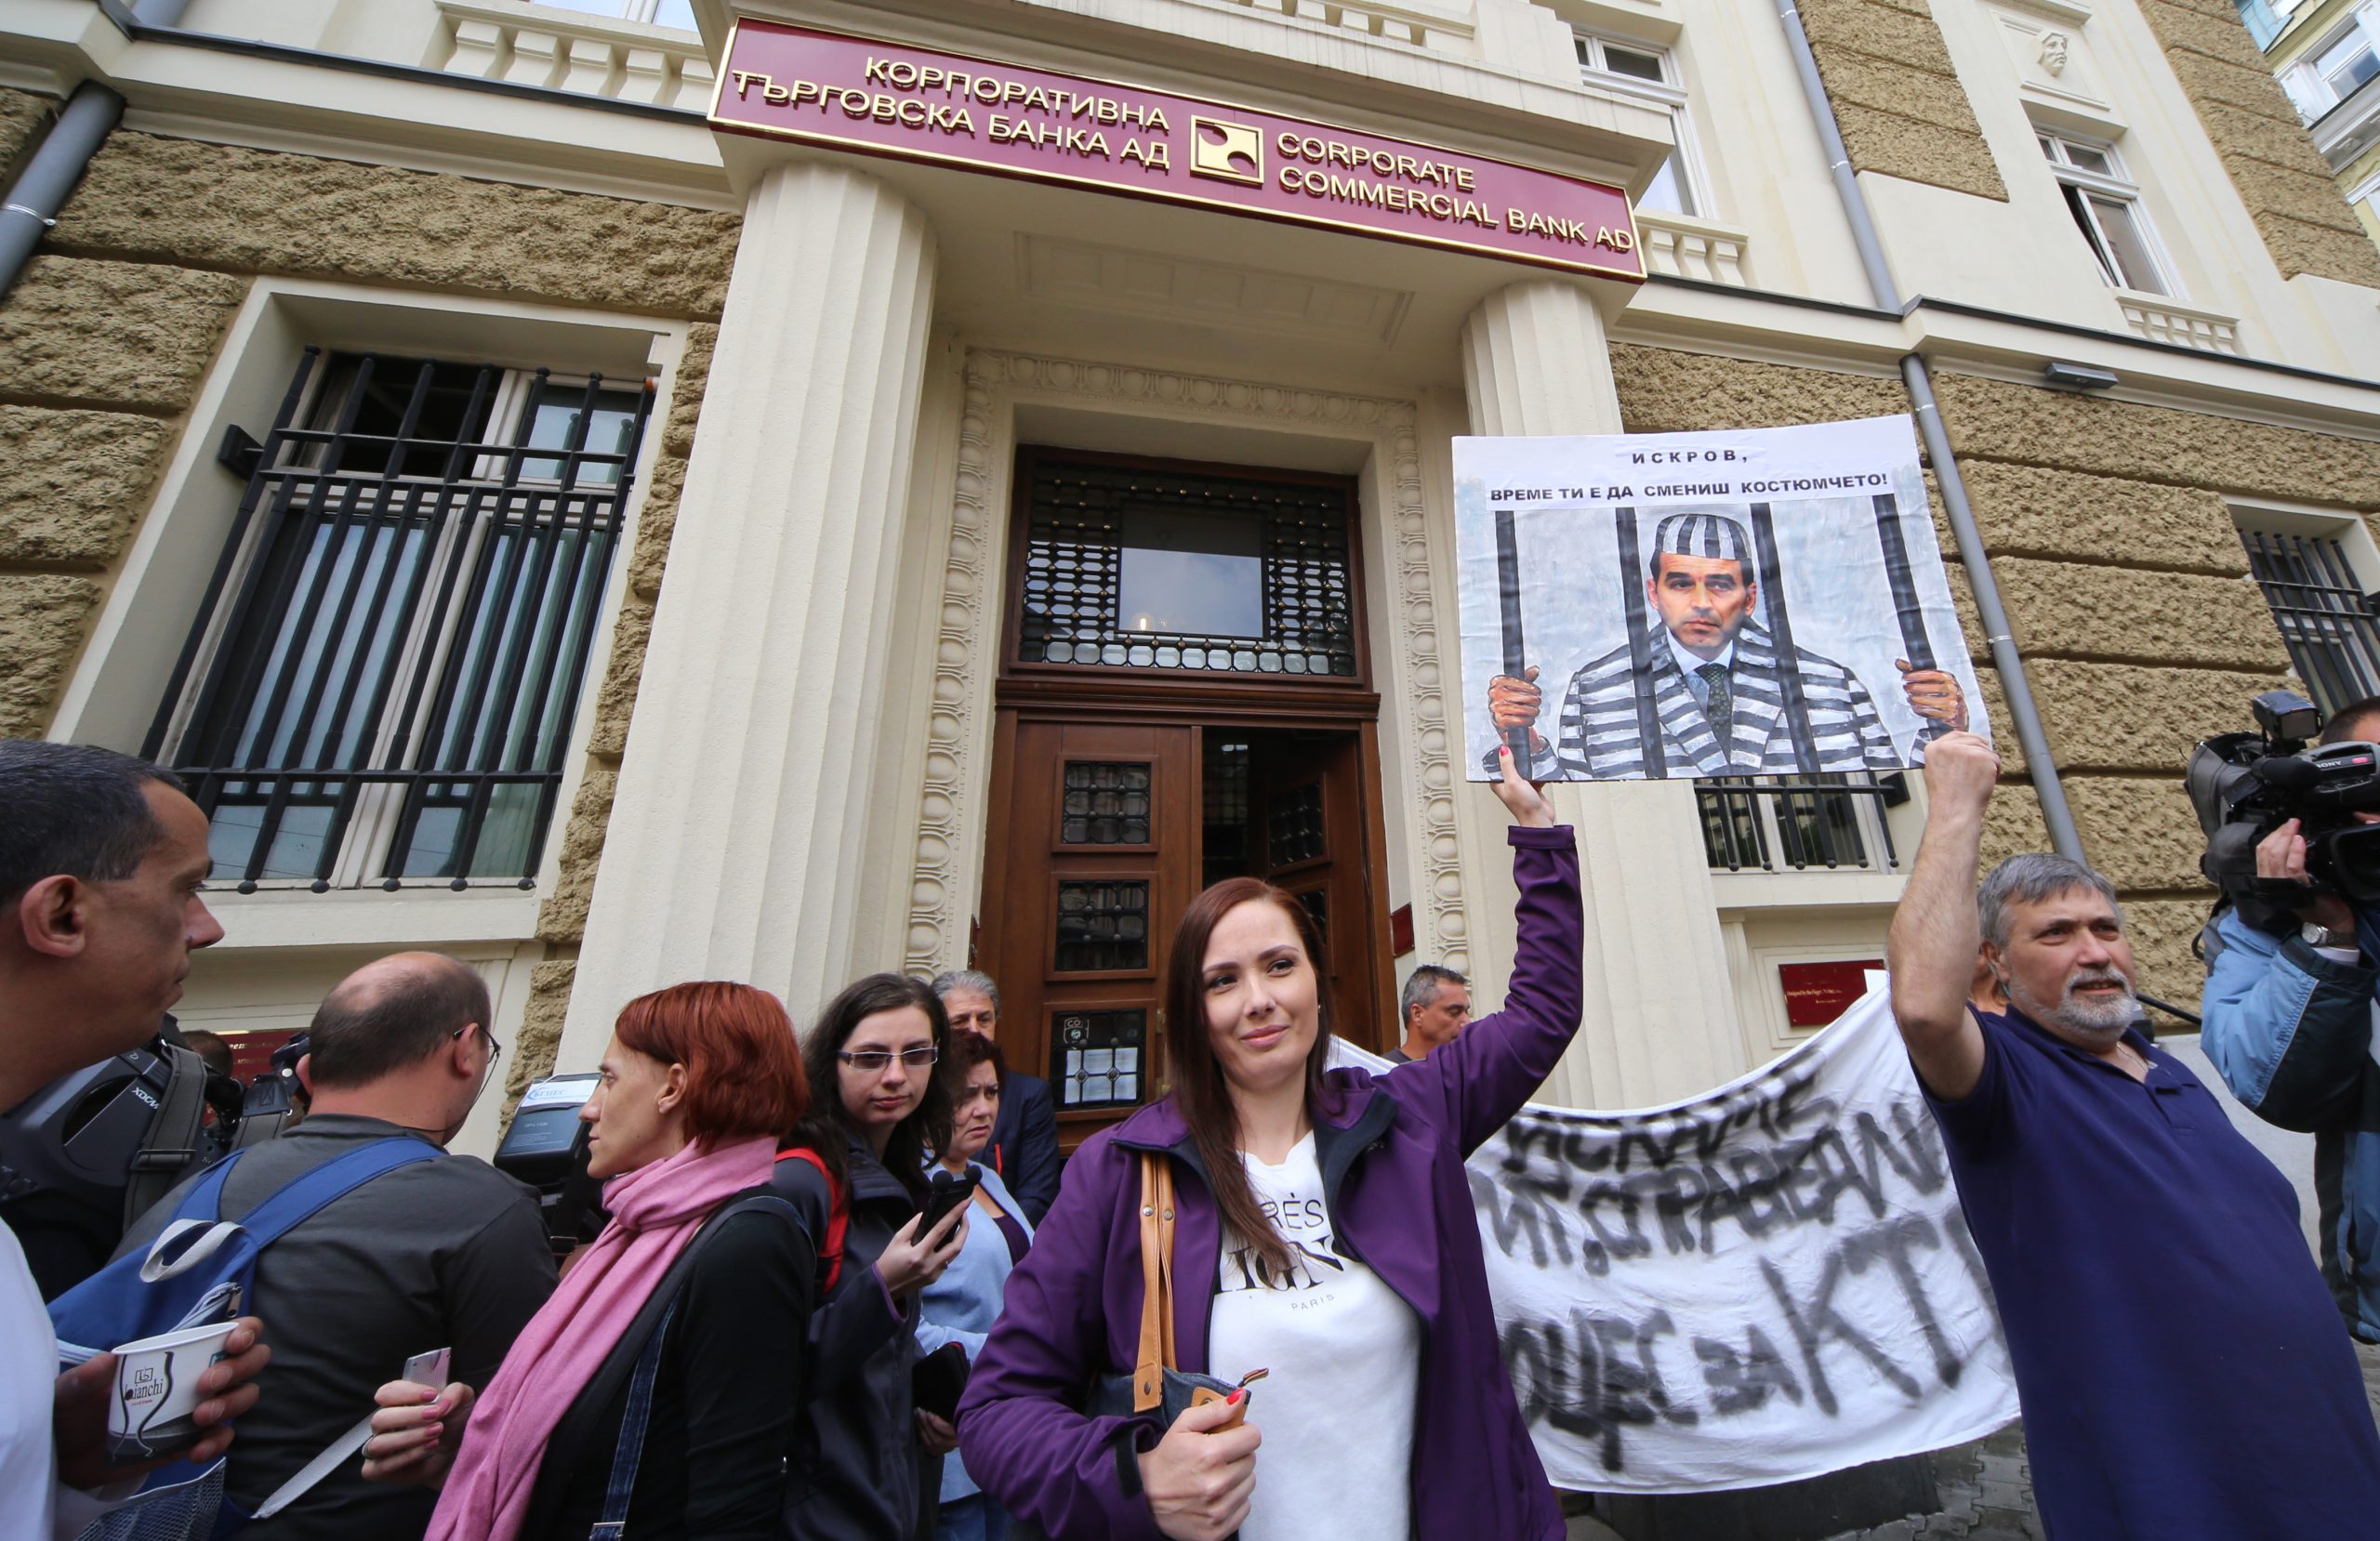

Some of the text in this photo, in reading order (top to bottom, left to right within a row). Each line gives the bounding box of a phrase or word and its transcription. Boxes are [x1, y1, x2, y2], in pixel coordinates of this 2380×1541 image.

[865, 57, 1170, 130] КОРПОРАТИВНА
[732, 70, 1170, 169] ТЪРГОВСКА БАНКА АД
[1277, 132, 1476, 190] CORPORATE
[1278, 166, 1634, 251] COMMERCIAL BANK AD
[1632, 449, 1748, 465] ИСКРОВ,
[1490, 473, 1888, 501] ВРЕМЕ ТИ Е ДА СМЕНИШ КОСТЮМЧЕТО!
[1260, 1192, 1325, 1230] RÈS
[1290, 1294, 1335, 1311] PARIS
[124, 1377, 165, 1402] bianchi
